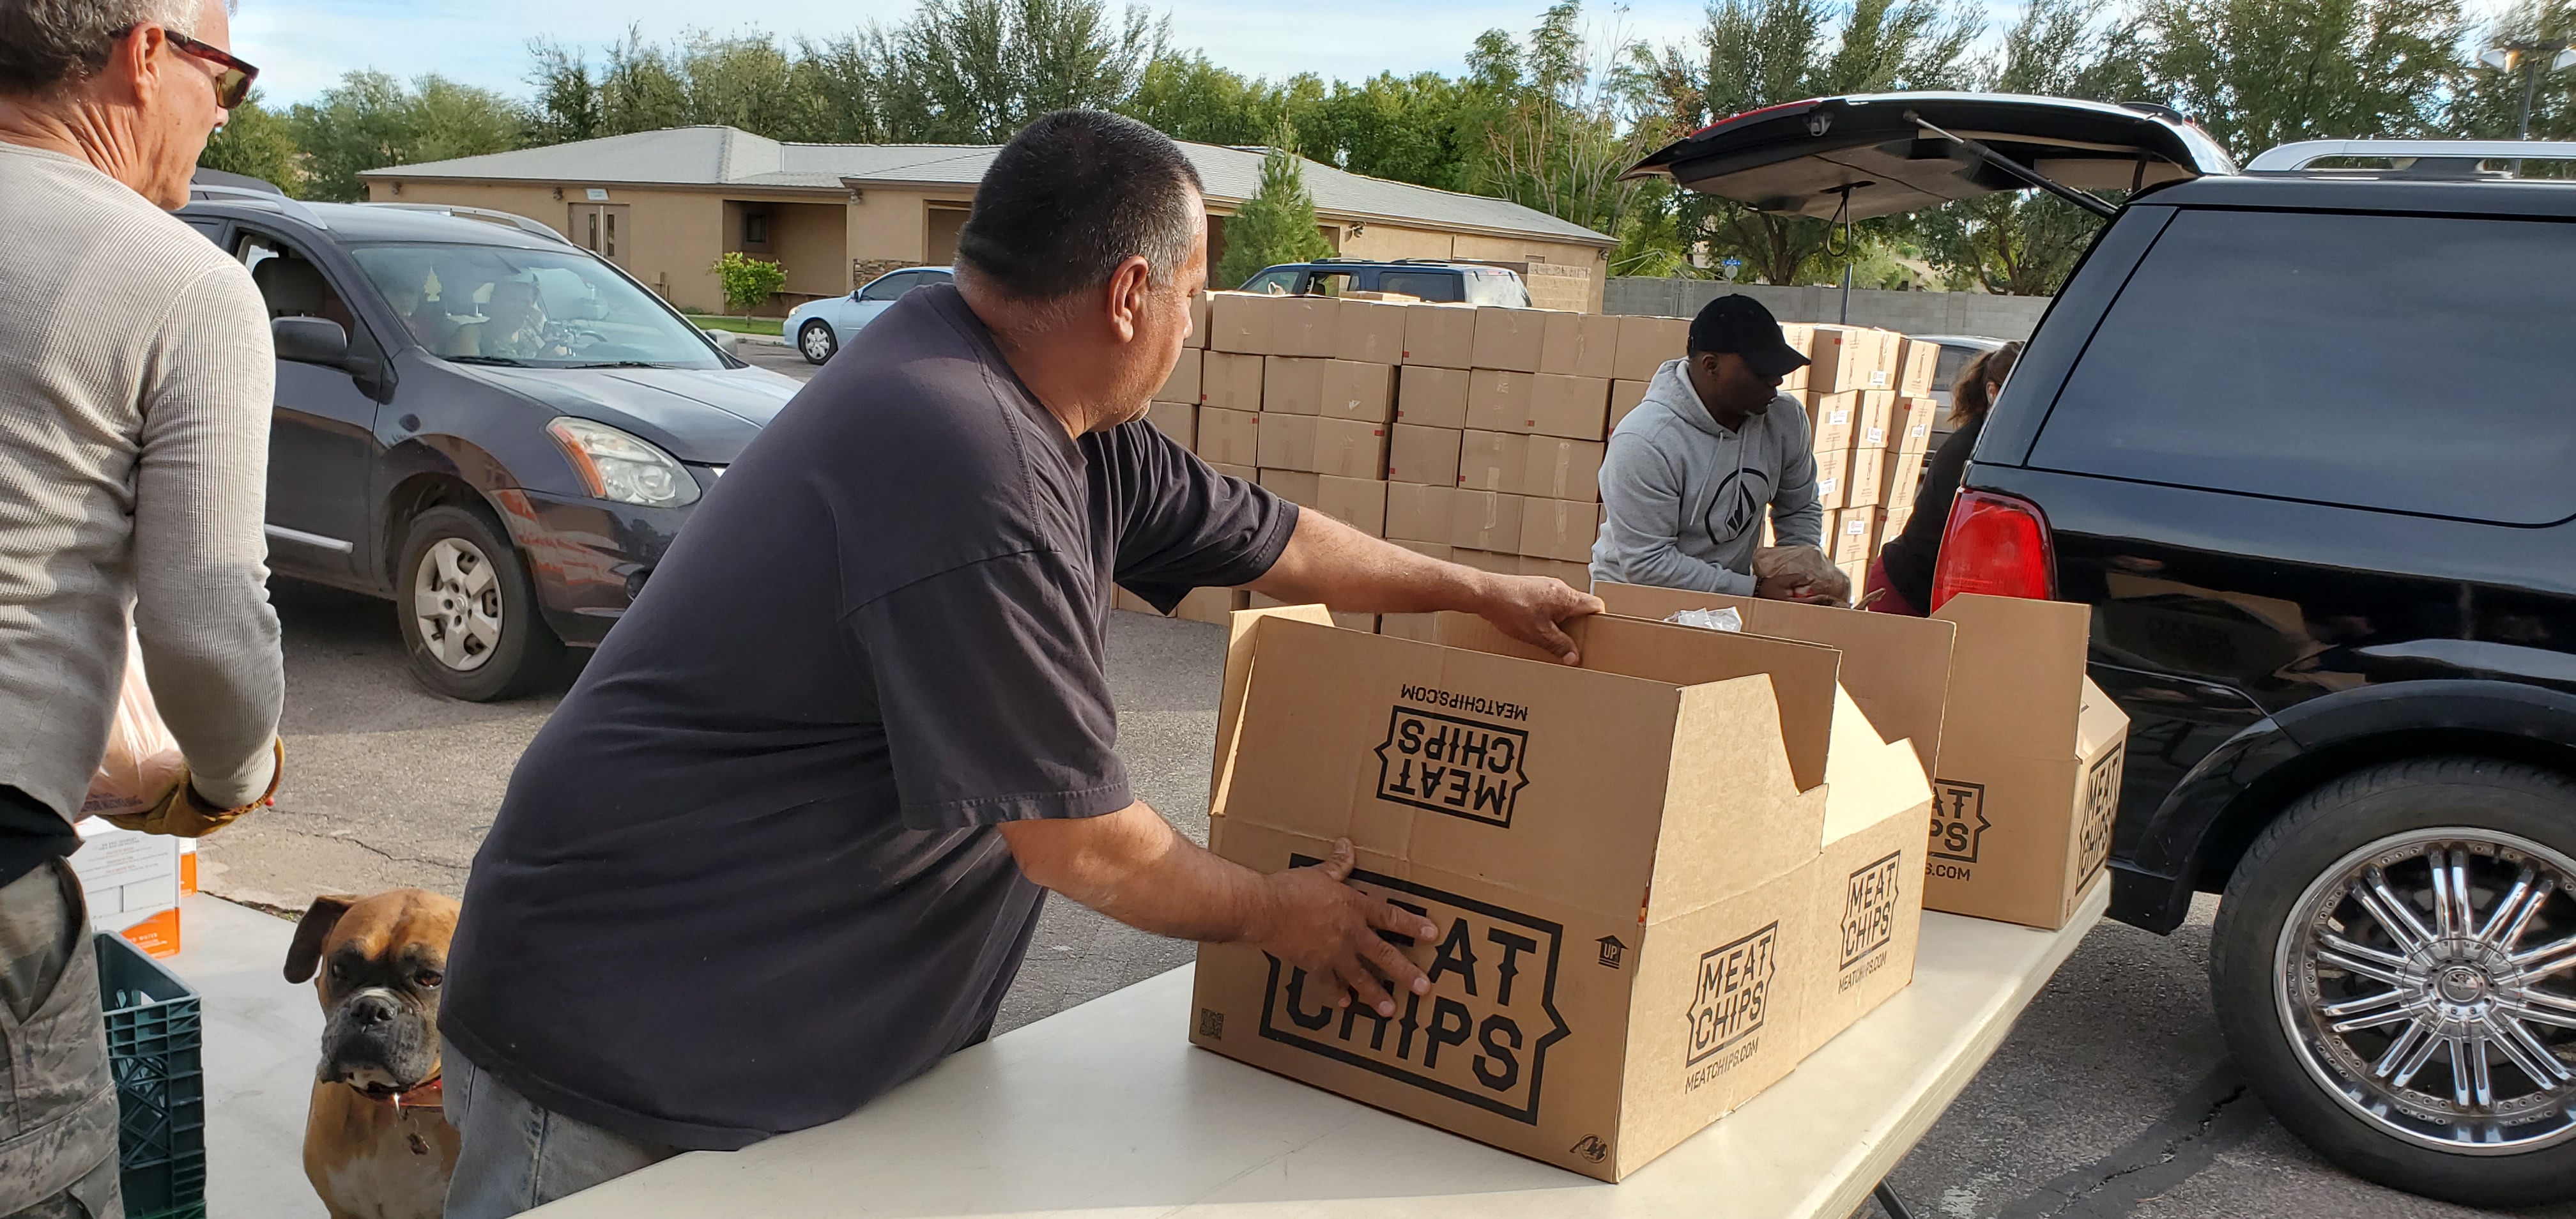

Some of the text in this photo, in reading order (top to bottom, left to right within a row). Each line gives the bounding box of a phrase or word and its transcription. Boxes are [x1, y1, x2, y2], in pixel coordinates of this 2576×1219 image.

[1401, 684, 1528, 721] MEATCHIPS.COM
[1398, 719, 1515, 774] CHIPS
[1390, 758, 1508, 816] MEAT
[1932, 786, 1972, 819] AT
[2086, 756, 2118, 826] MEAT
[2080, 807, 2111, 878] CHIPS
[1850, 861, 1896, 918] MEAT
[1356, 890, 1537, 1007] AT
[1604, 943, 1618, 959] UP
[1846, 901, 1890, 957] CHIPS
[1701, 935, 1772, 1005] MEAT
[1838, 950, 1887, 995] MEATCHIPS.COM
[1696, 980, 1764, 1050] CHIPS
[1685, 1037, 1759, 1094] MEATCHIPS.COM
